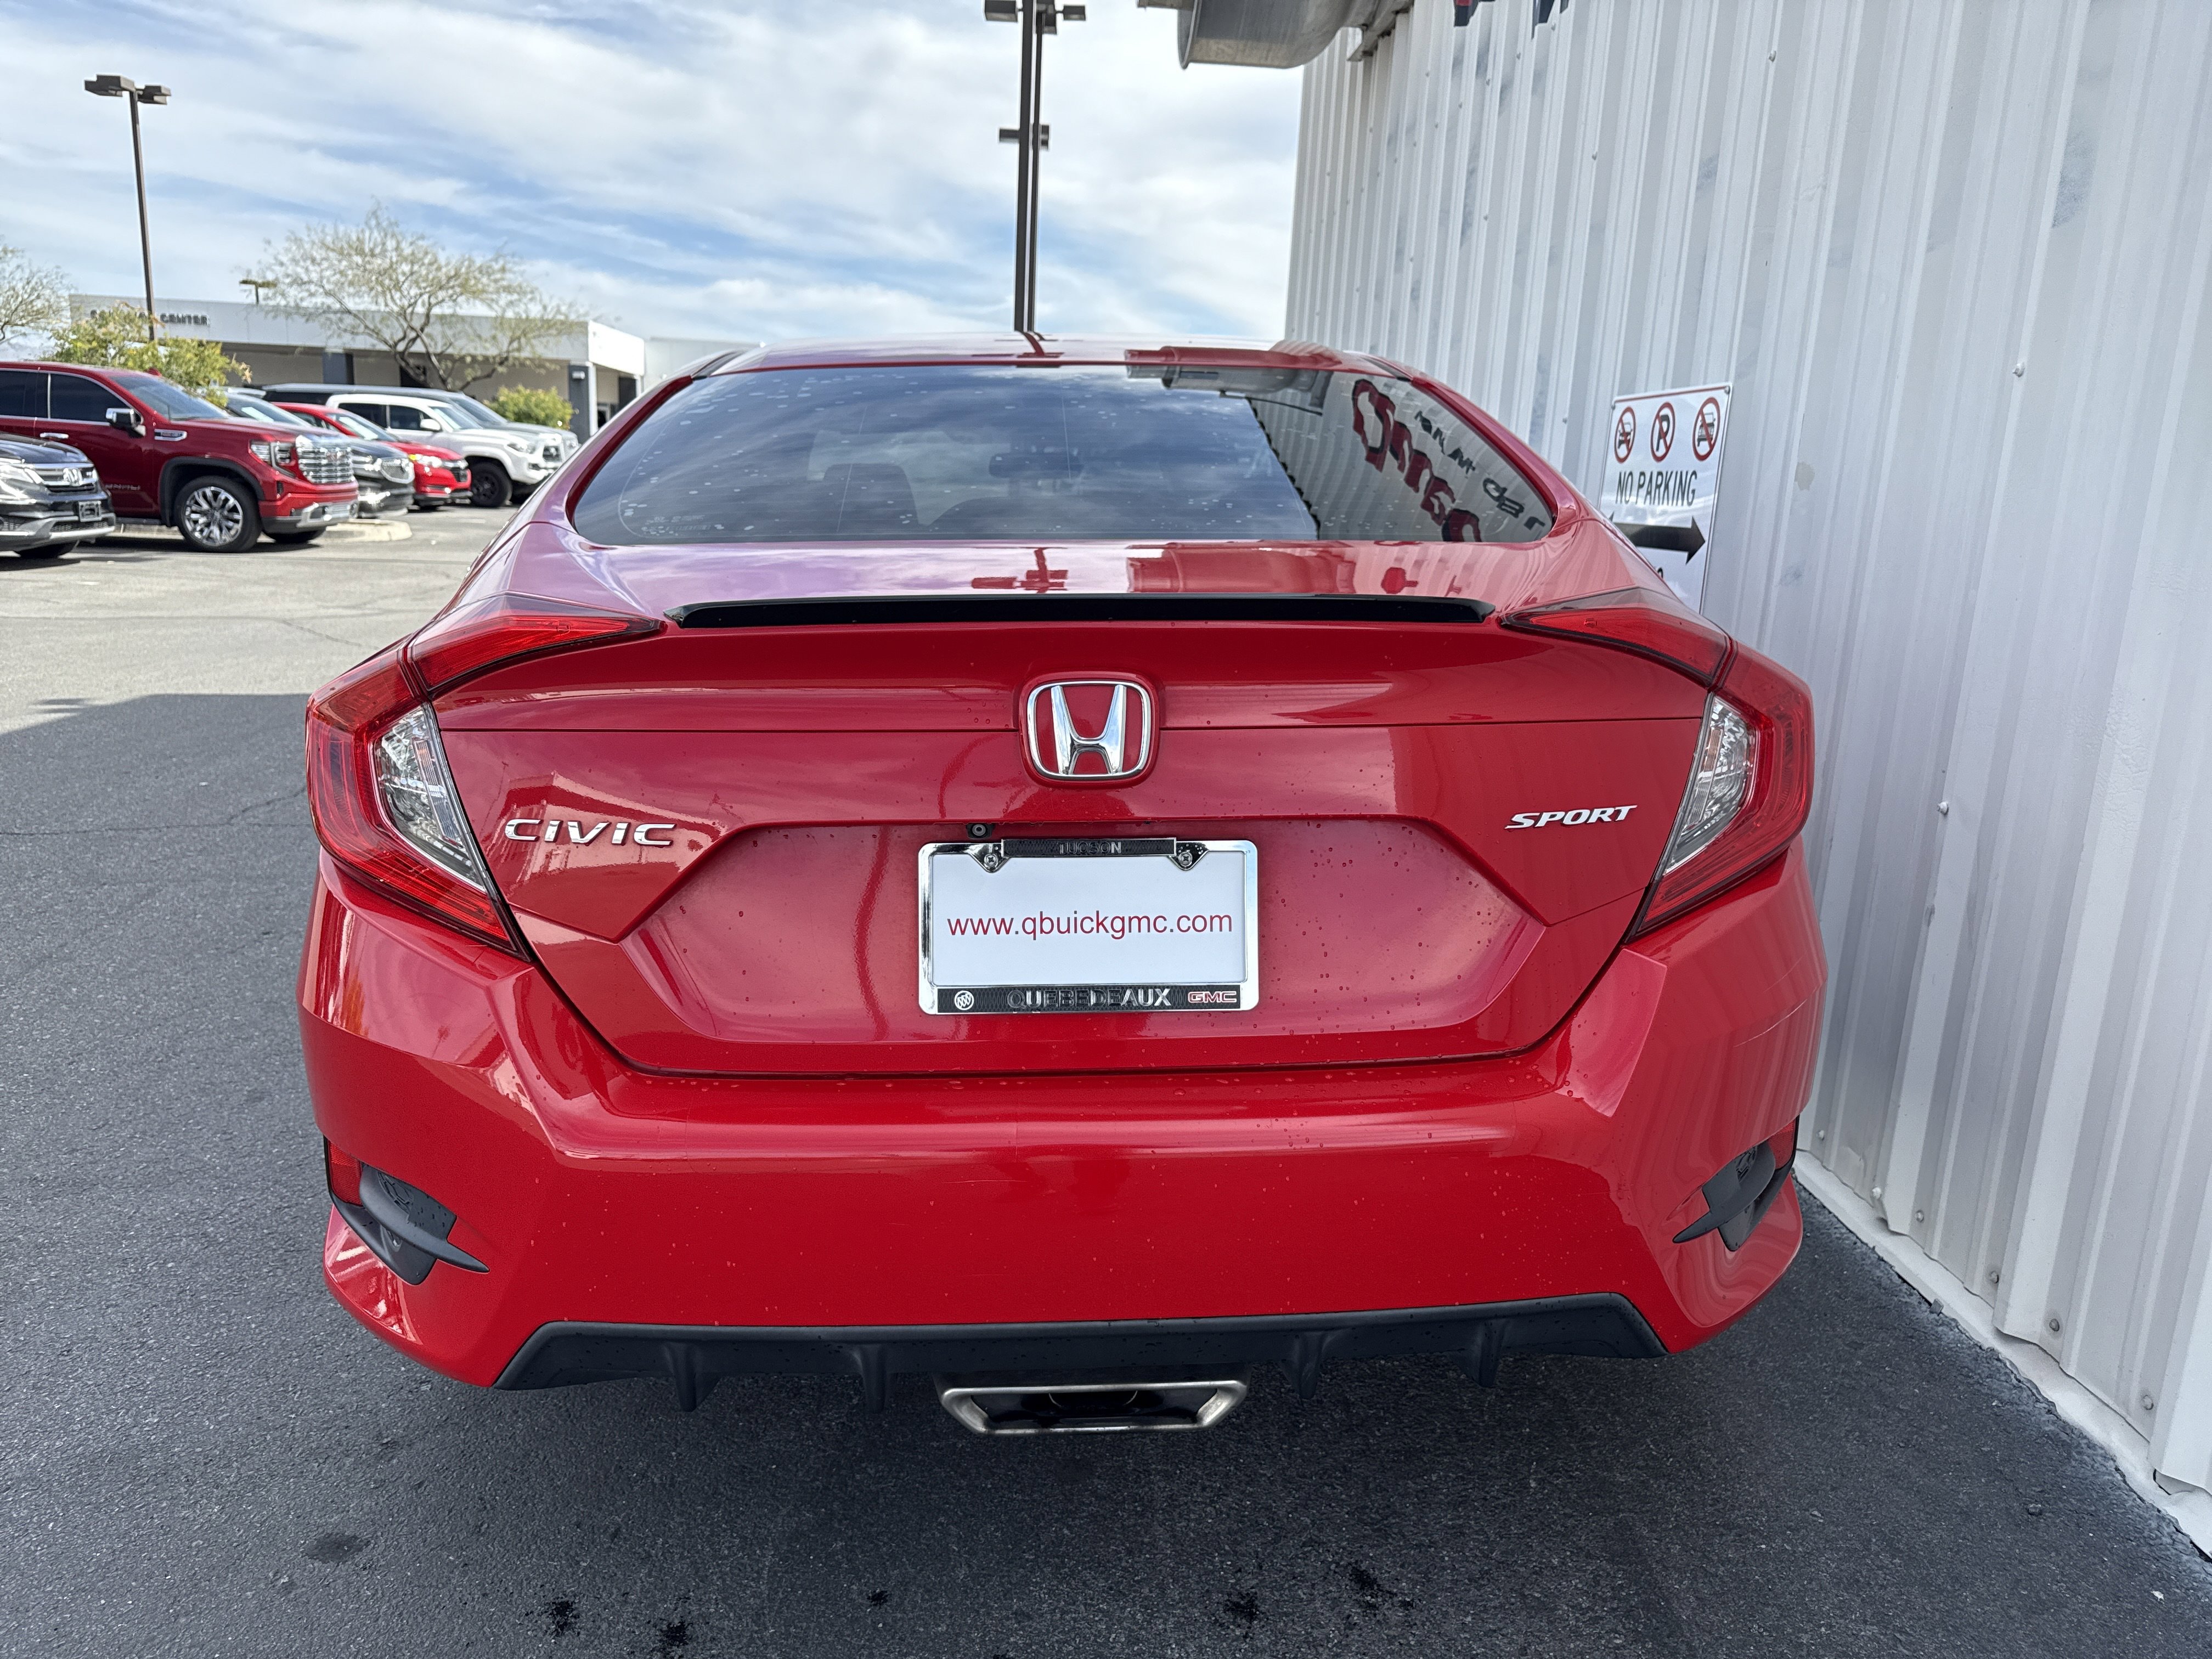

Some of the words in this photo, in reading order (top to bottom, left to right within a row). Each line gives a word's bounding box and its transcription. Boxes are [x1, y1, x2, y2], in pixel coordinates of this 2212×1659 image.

[1615, 471, 1633, 505] NO
[1635, 470, 1697, 506] PARKING
[1504, 805, 1638, 830] SPORT
[504, 819, 677, 848] CIVIC
[947, 911, 1233, 940] www.qbuickgmc.com
[1007, 988, 1171, 1010] QUEBEDEAUX
[1188, 991, 1237, 1003] GMC
